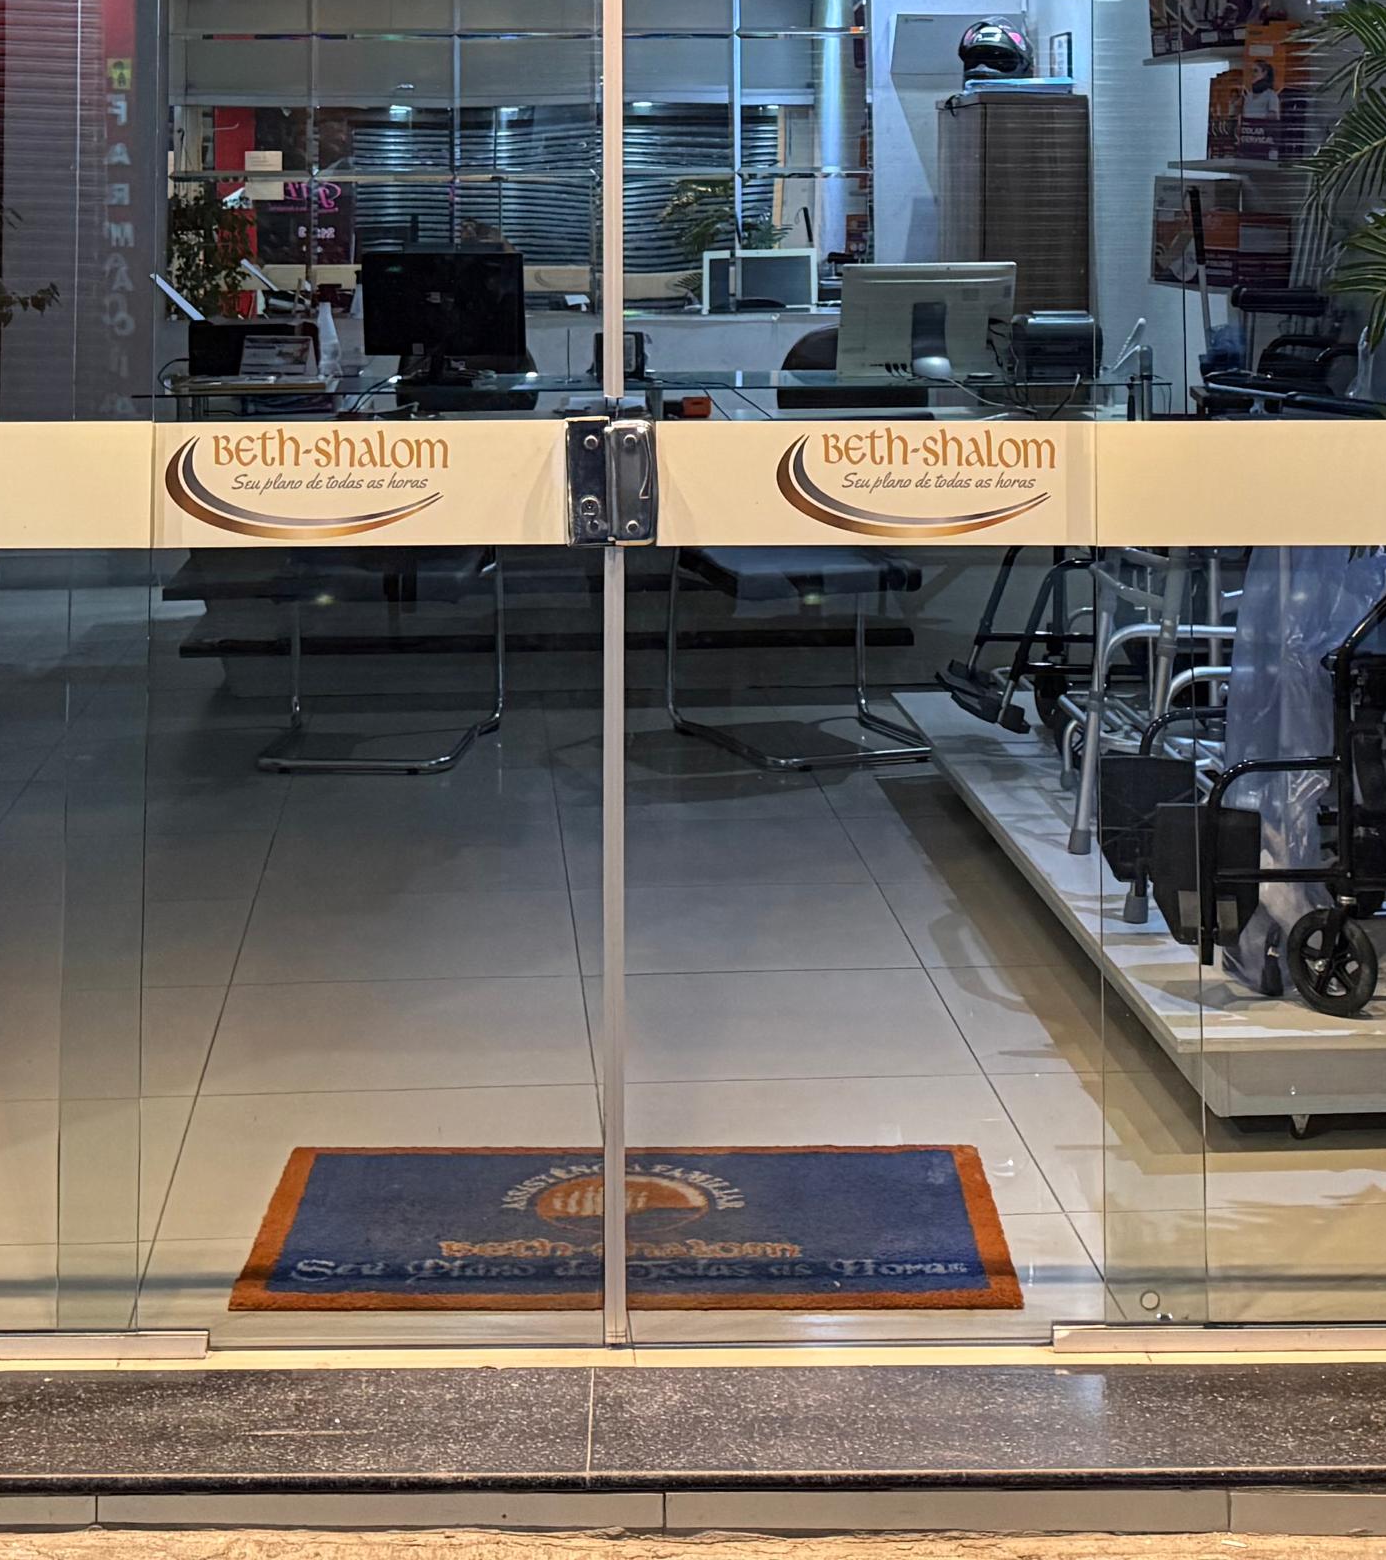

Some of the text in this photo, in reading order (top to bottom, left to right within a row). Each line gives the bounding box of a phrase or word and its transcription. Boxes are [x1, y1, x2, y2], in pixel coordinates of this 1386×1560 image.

[231, 472, 428, 495] Seu plano de todas as horas
[841, 471, 1037, 494] Seu plano de todas as horas
